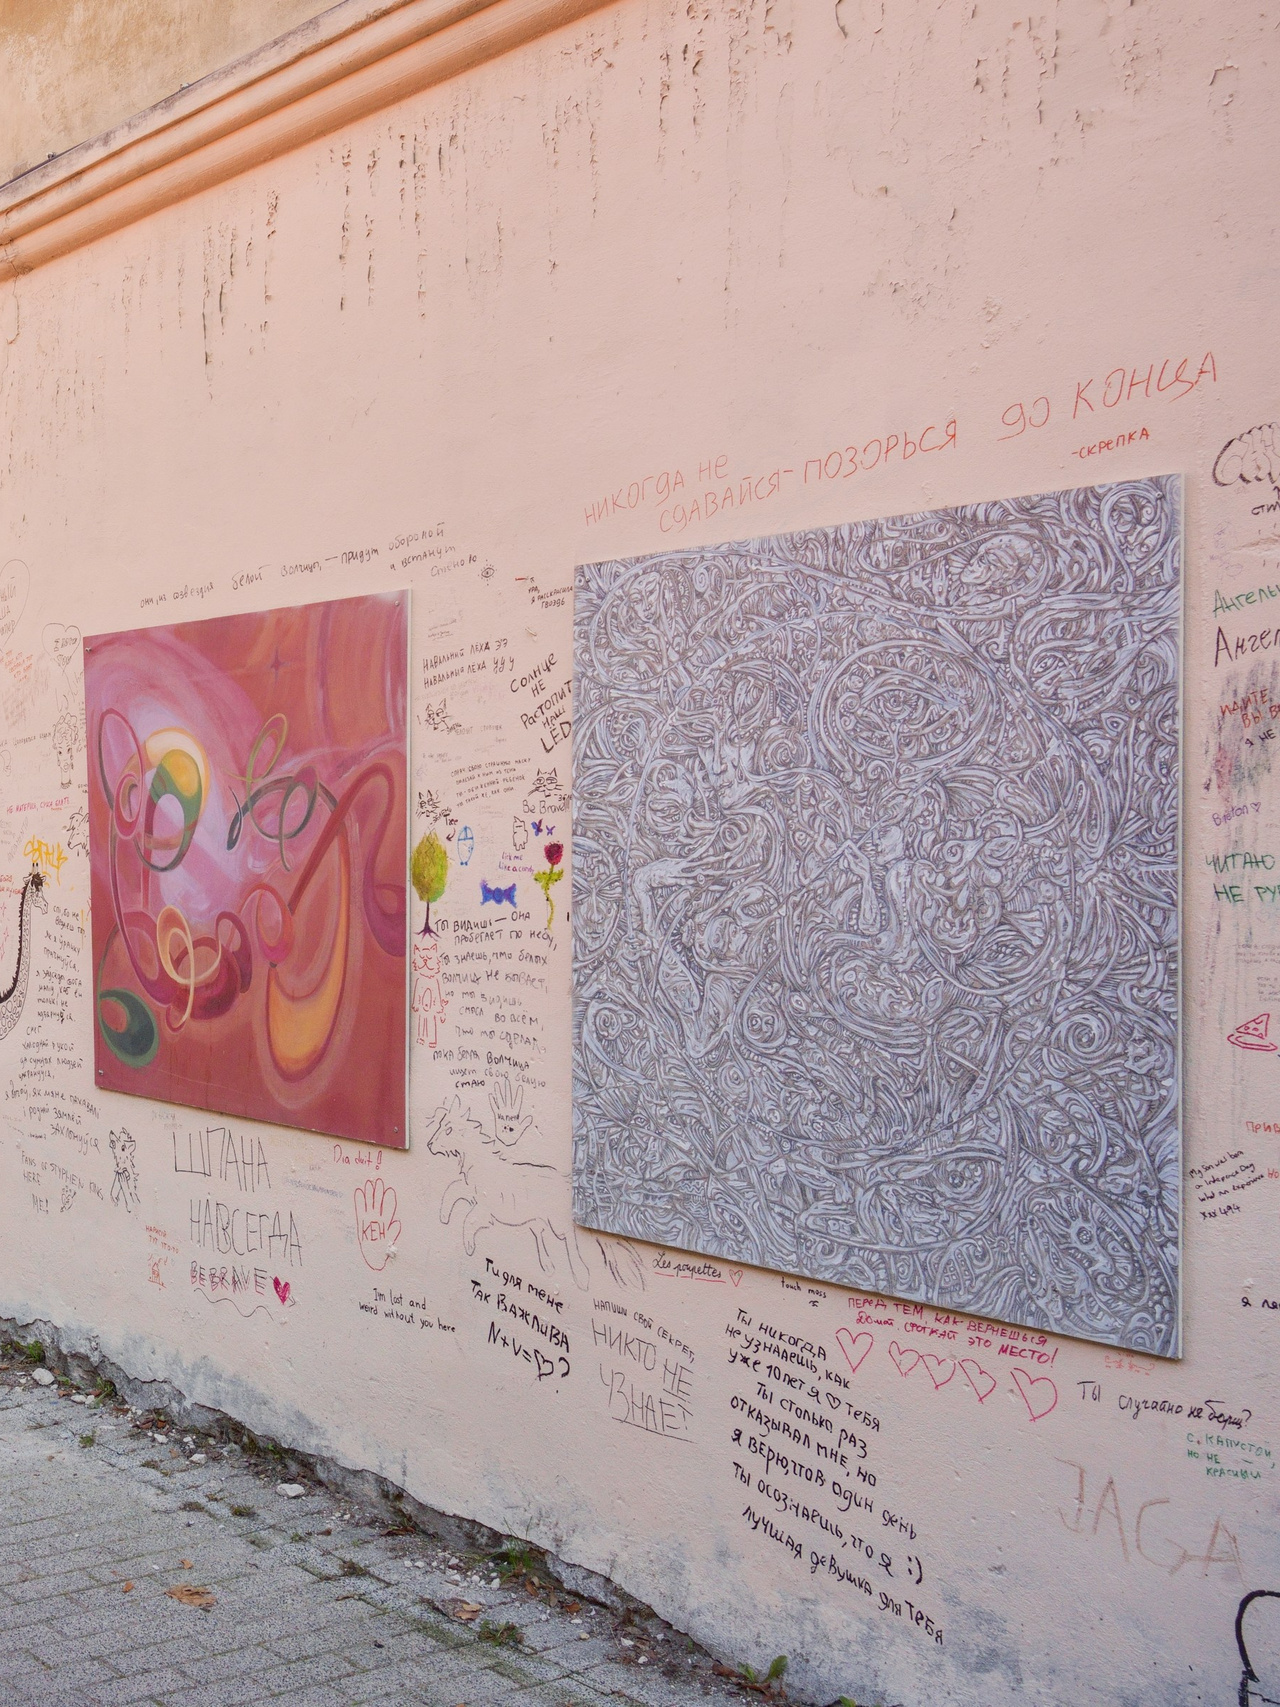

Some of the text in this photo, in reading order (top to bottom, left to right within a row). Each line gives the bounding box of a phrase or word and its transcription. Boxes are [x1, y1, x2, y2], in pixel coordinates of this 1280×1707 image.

[190, 1199, 302, 1266] НАВСЕГДА
[591, 1318, 694, 1397] НИКТО НЕ
[766, 1363, 781, 1384] 10
